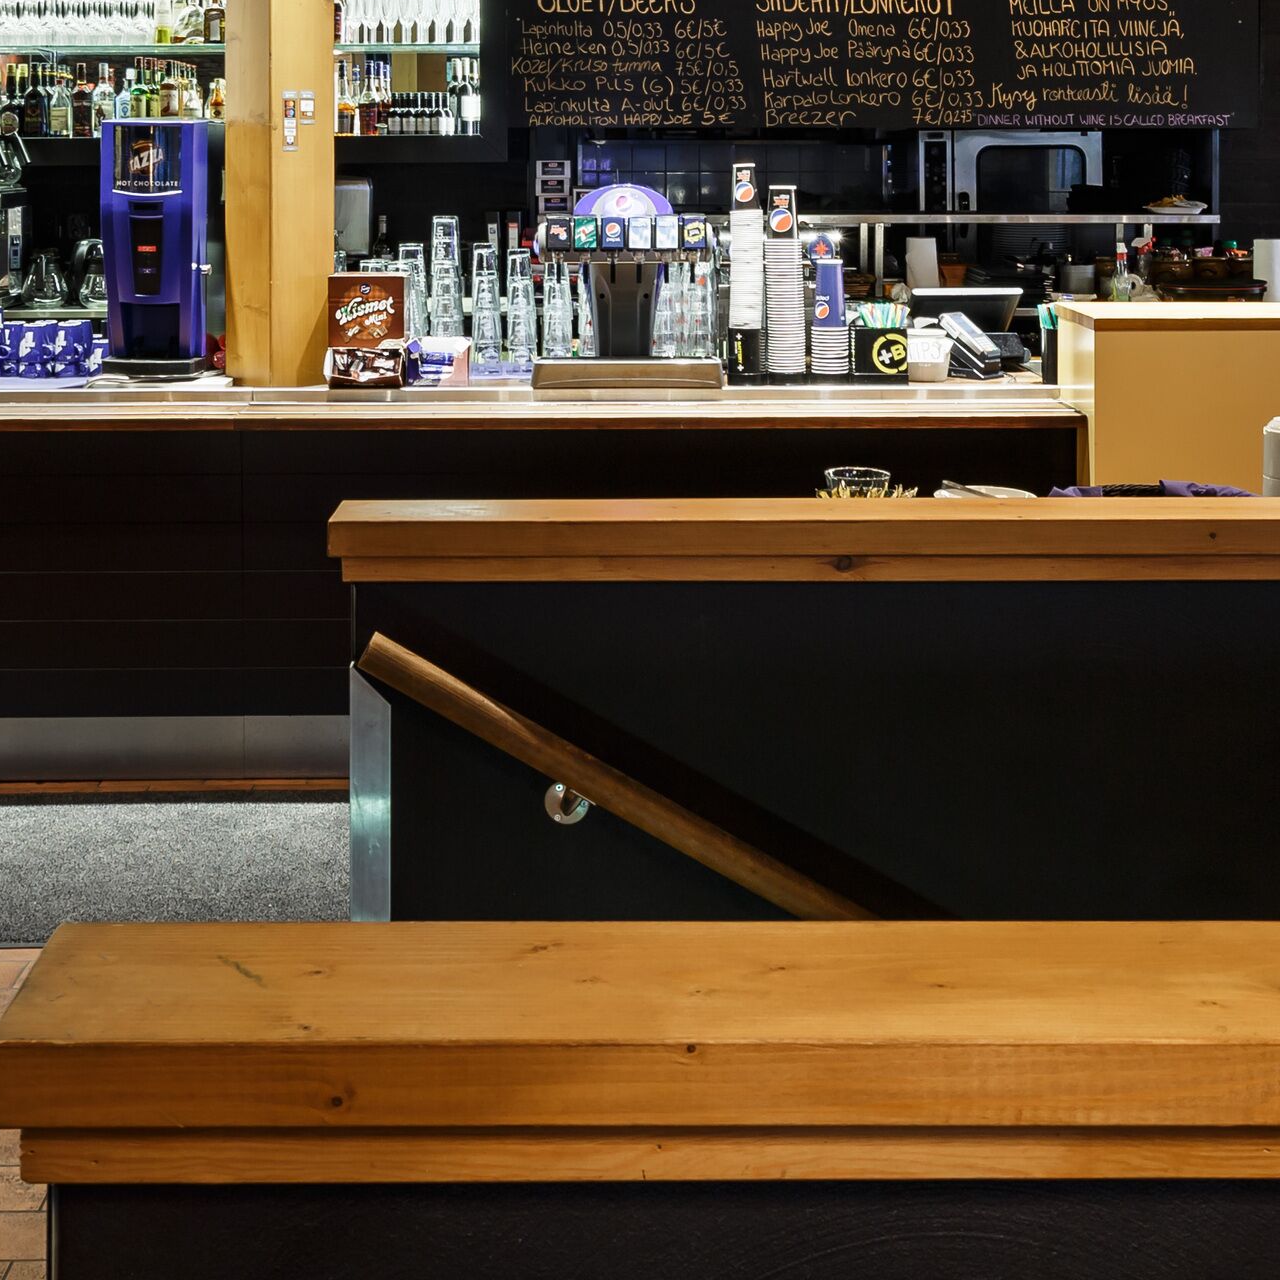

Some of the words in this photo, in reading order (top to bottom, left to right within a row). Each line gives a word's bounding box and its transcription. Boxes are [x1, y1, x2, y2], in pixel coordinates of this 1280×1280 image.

[756, 19, 802, 42] Happy
[807, 18, 832, 36] Joe
[848, 19, 896, 37] Omena
[761, 43, 811, 65] Happy
[814, 42, 839, 60] Joe
[762, 66, 838, 88] Hartwall
[1017, 63, 1038, 80] JA
[988, 82, 1037, 112] Kysy
[765, 108, 857, 127] Breezer
[1024, 113, 1075, 126] WITHOUT
[1079, 113, 1106, 126] WINE
[335, 296, 395, 325] Kismet
